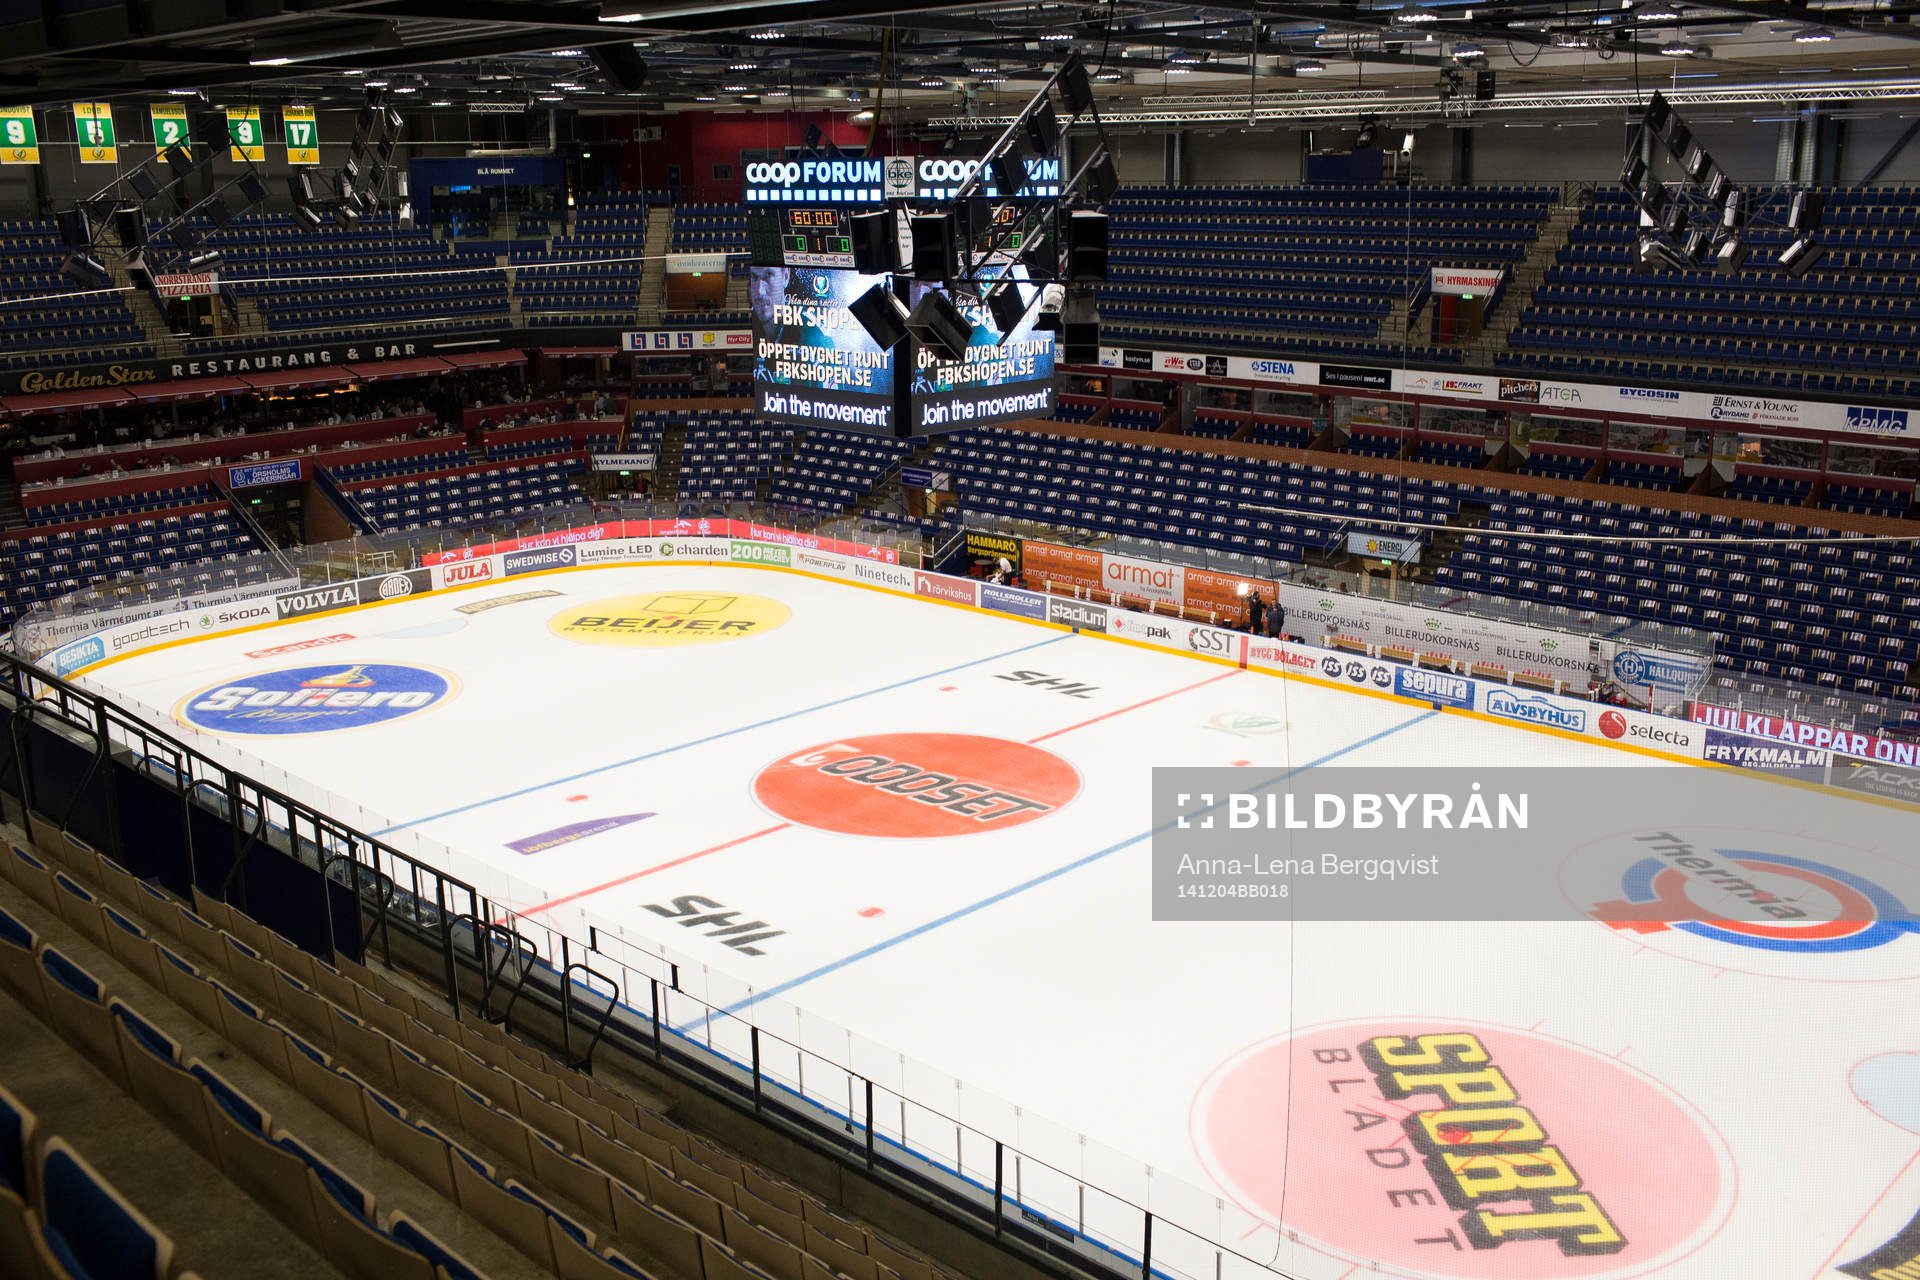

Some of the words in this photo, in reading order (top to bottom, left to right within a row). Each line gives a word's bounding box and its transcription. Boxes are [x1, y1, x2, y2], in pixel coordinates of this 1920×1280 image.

[6, 120, 26, 145] 9
[86, 120, 104, 145] 5
[163, 121, 180, 144] 2
[238, 121, 253, 144] 9
[290, 123, 311, 145] 17
[803, 160, 881, 183] FORUM
[887, 169, 913, 179] bke
[793, 211, 833, 225] 60:00
[796, 237, 805, 250] 0
[840, 238, 849, 252] 0
[160, 284, 212, 296] PIZZERIA
[773, 304, 804, 327] FBK
[806, 306, 864, 331] SHOPE
[758, 338, 799, 361] ÖPPET
[800, 345, 854, 366] DYGNET
[854, 351, 890, 370] RUNT
[965, 344, 1017, 362] DYGNET
[1016, 338, 1052, 357] RUNT
[20, 372, 106, 394] Golden
[105, 365, 156, 387] Star
[171, 350, 332, 377] RESTAURANG
[346, 349, 359, 360] &
[375, 343, 417, 359] BAR
[775, 361, 872, 387] FBKSHOPEN.SE
[937, 359, 1035, 385] FBKSHOPEN.SE
[1260, 361, 1295, 375] STENA
[1458, 380, 1483, 390] FRAKT
[1501, 382, 1539, 397] pitchers
[1541, 386, 1582, 402] ATEA
[1619, 387, 1680, 400] BYCOSIN
[763, 392, 788, 413] Join
[789, 396, 812, 416] the
[813, 401, 888, 426] movement
[921, 402, 949, 425] Join
[951, 399, 975, 420] the
[977, 389, 1048, 417] movement
[1724, 396, 1755, 409] ERNST
[1754, 400, 1761, 410] &
[1762, 400, 1799, 413] YOUNG
[1843, 416, 1903, 434] KPMG
[587, 527, 605, 541] dig?
[966, 533, 1016, 552] HAMMARÖ
[580, 546, 625, 558] Lumine
[629, 545, 653, 554] LED
[677, 544, 728, 556] charden
[731, 544, 762, 560] 200
[1024, 544, 1049, 555] armat
[1049, 548, 1074, 560] armat
[1075, 553, 1099, 564] armat
[506, 552, 559, 570] SWEDWISE
[446, 562, 491, 583] JULA
[1024, 567, 1048, 578] armat
[1107, 562, 1174, 590] armat
[1187, 572, 1214, 583] armat
[276, 586, 357, 614] VOLVIA
[1186, 598, 1213, 609] armat
[1215, 602, 1242, 615] armat
[570, 615, 755, 632] BEIJER
[1051, 602, 1106, 627] stadium
[1283, 606, 1370, 631] BILLERUDKORSNÄS
[45, 623, 90, 637] Thermia
[112, 620, 190, 650] goodtech
[1385, 625, 1480, 652] BILLERUDKORSNÄS
[1274, 648, 1316, 670] BOLAGET
[995, 669, 1102, 699] SHL
[1402, 669, 1467, 700] sepura
[194, 686, 435, 711] Sofiero
[1630, 722, 1689, 747] selecta
[1696, 706, 1869, 756] JULKLAPPAR
[1704, 745, 1826, 766] FRYKMALM
[819, 755, 1051, 823] ODDSET
[1632, 830, 1809, 921] Thermia
[640, 894, 787, 957] SHL
[1312, 1047, 1464, 1252] BLADET
[1358, 1032, 1629, 1258] SPORT
